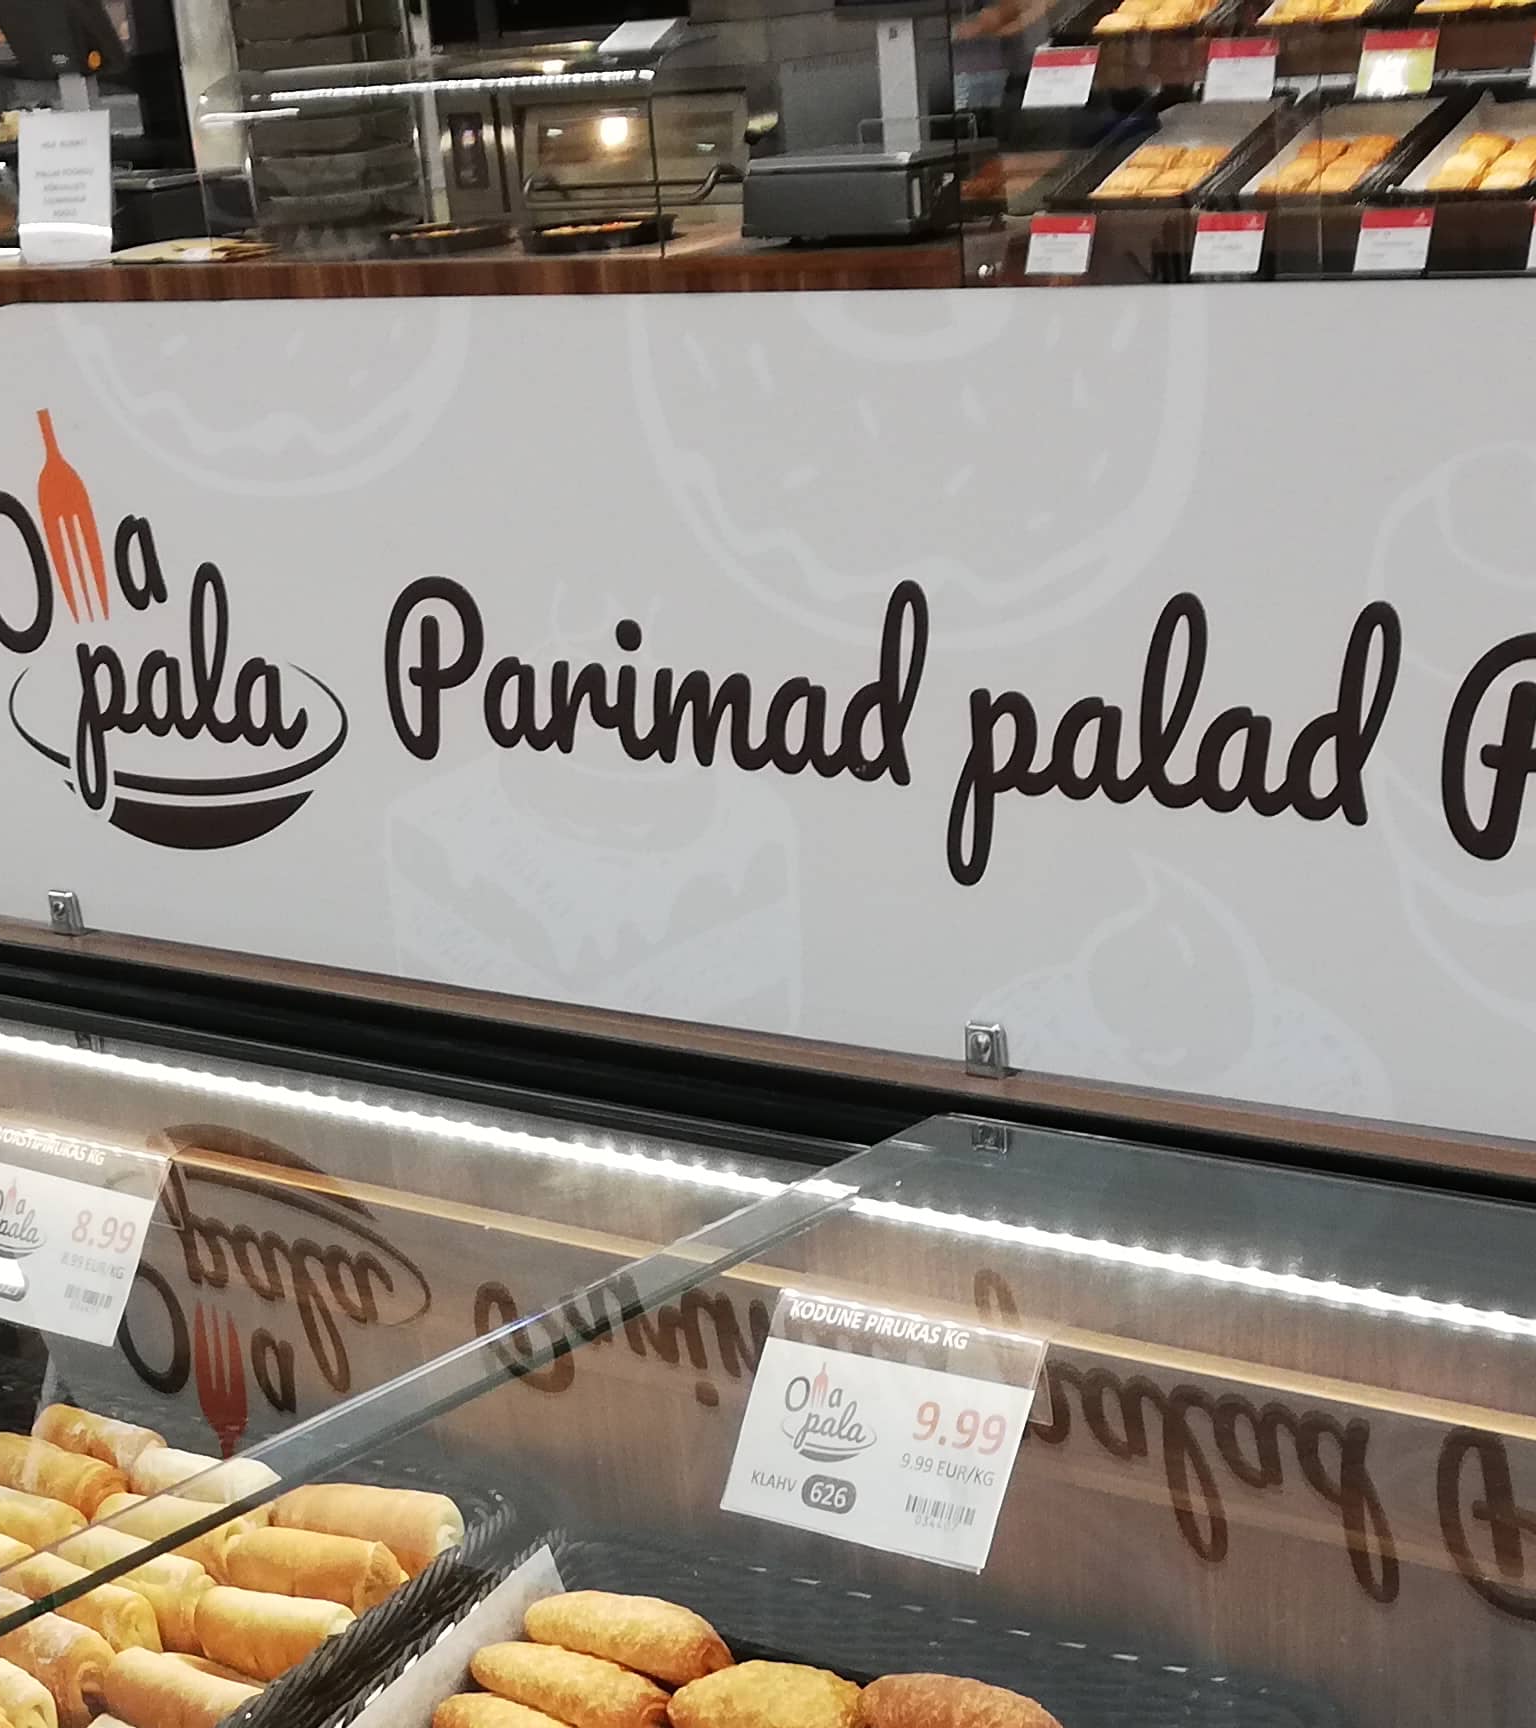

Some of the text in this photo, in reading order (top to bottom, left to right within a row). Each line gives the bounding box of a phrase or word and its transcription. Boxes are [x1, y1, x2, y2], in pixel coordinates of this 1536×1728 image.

[75, 562, 308, 811] pala
[384, 576, 928, 786] Parimad
[946, 592, 1402, 885] palad
[86, 1149, 107, 1166] KG
[71, 1210, 137, 1254] 8.99
[789, 1298, 971, 1351] KODUNE PIRUKAS KG
[794, 1398, 867, 1448] pala
[912, 1401, 1007, 1456] 9.99
[751, 1469, 797, 1494] KLAHV
[900, 1453, 995, 1488] 9.99 EUR/KG
[808, 1480, 849, 1509] 626
